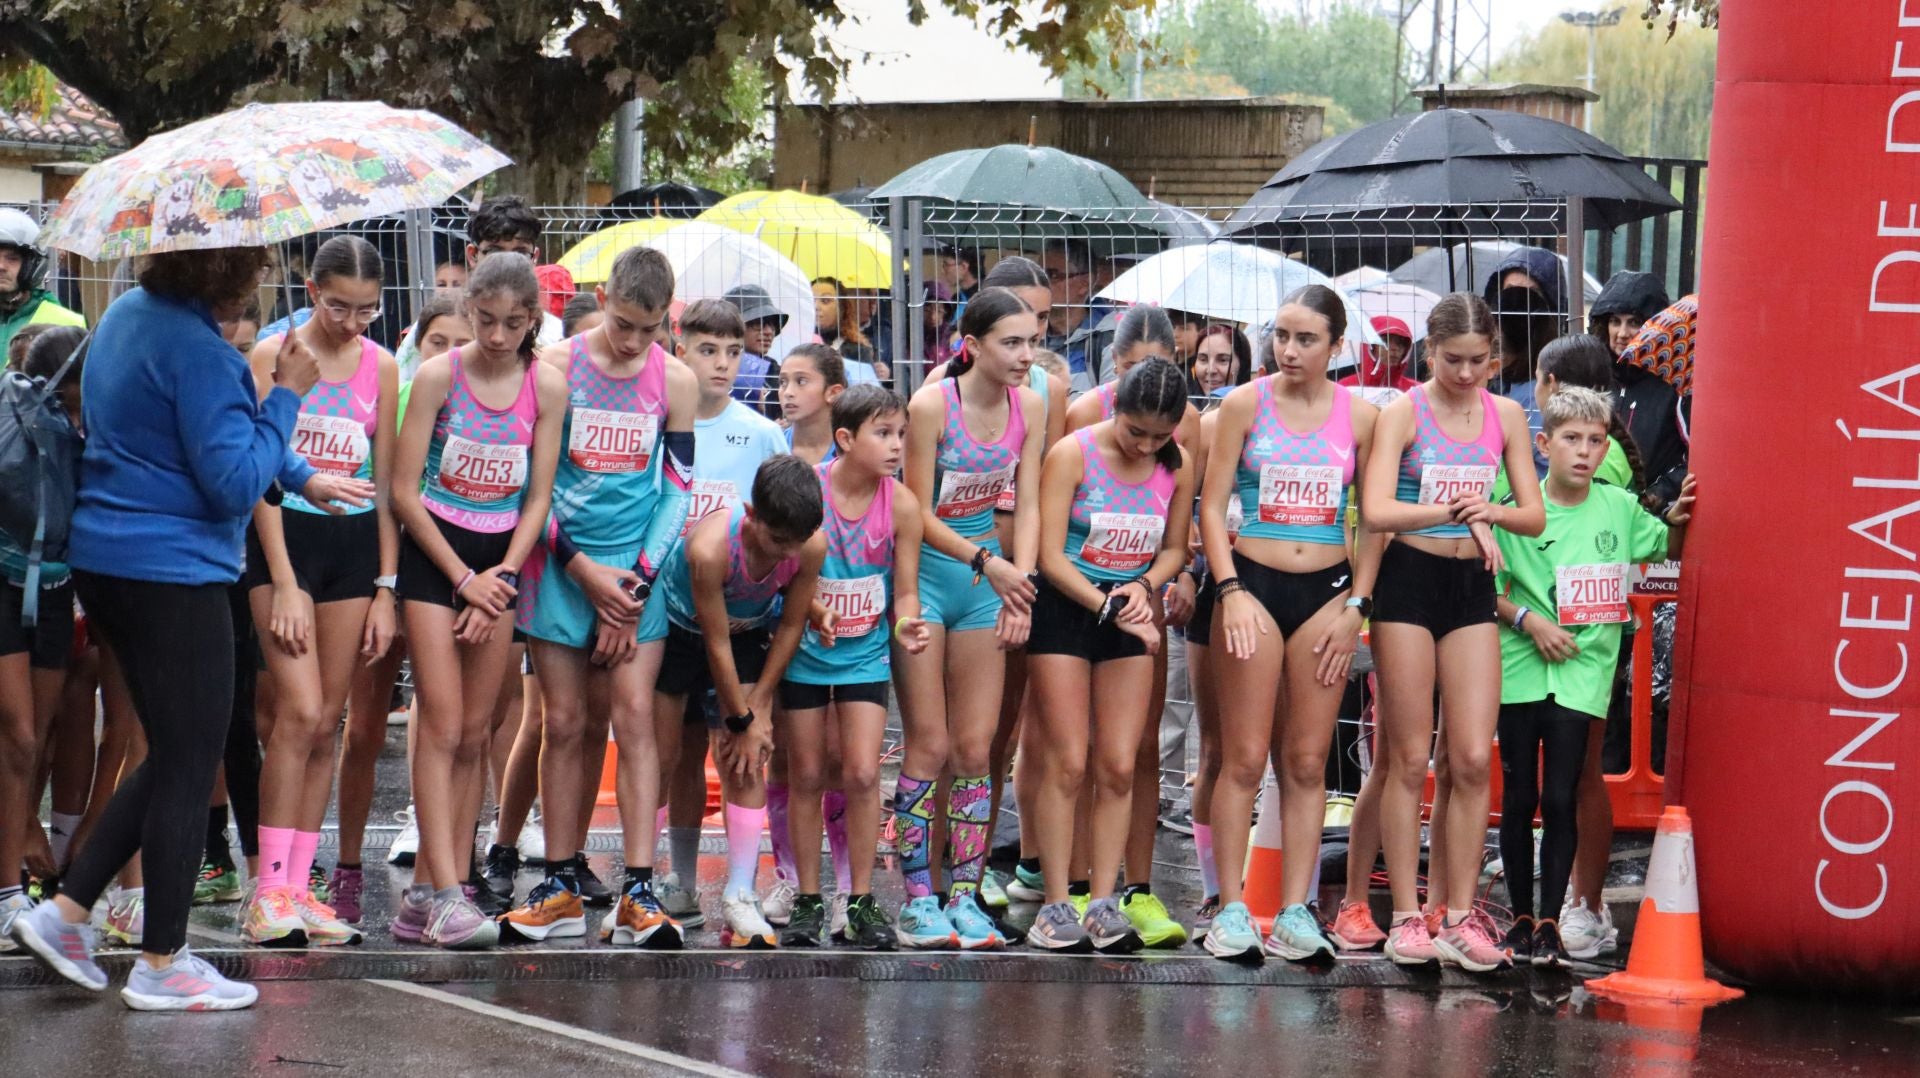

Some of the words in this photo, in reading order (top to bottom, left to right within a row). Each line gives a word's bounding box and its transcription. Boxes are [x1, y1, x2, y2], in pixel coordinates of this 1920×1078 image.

[295, 429, 354, 460] 2044
[584, 425, 642, 453] 2006
[454, 453, 513, 484] 2053
[951, 477, 1004, 503] 2046
[1273, 480, 1329, 506] 2048
[1102, 528, 1149, 552] 2041
[821, 590, 873, 617] 2004
[1571, 578, 1620, 604] 2008
[1814, 363, 1920, 920] CONCEJALÍA
